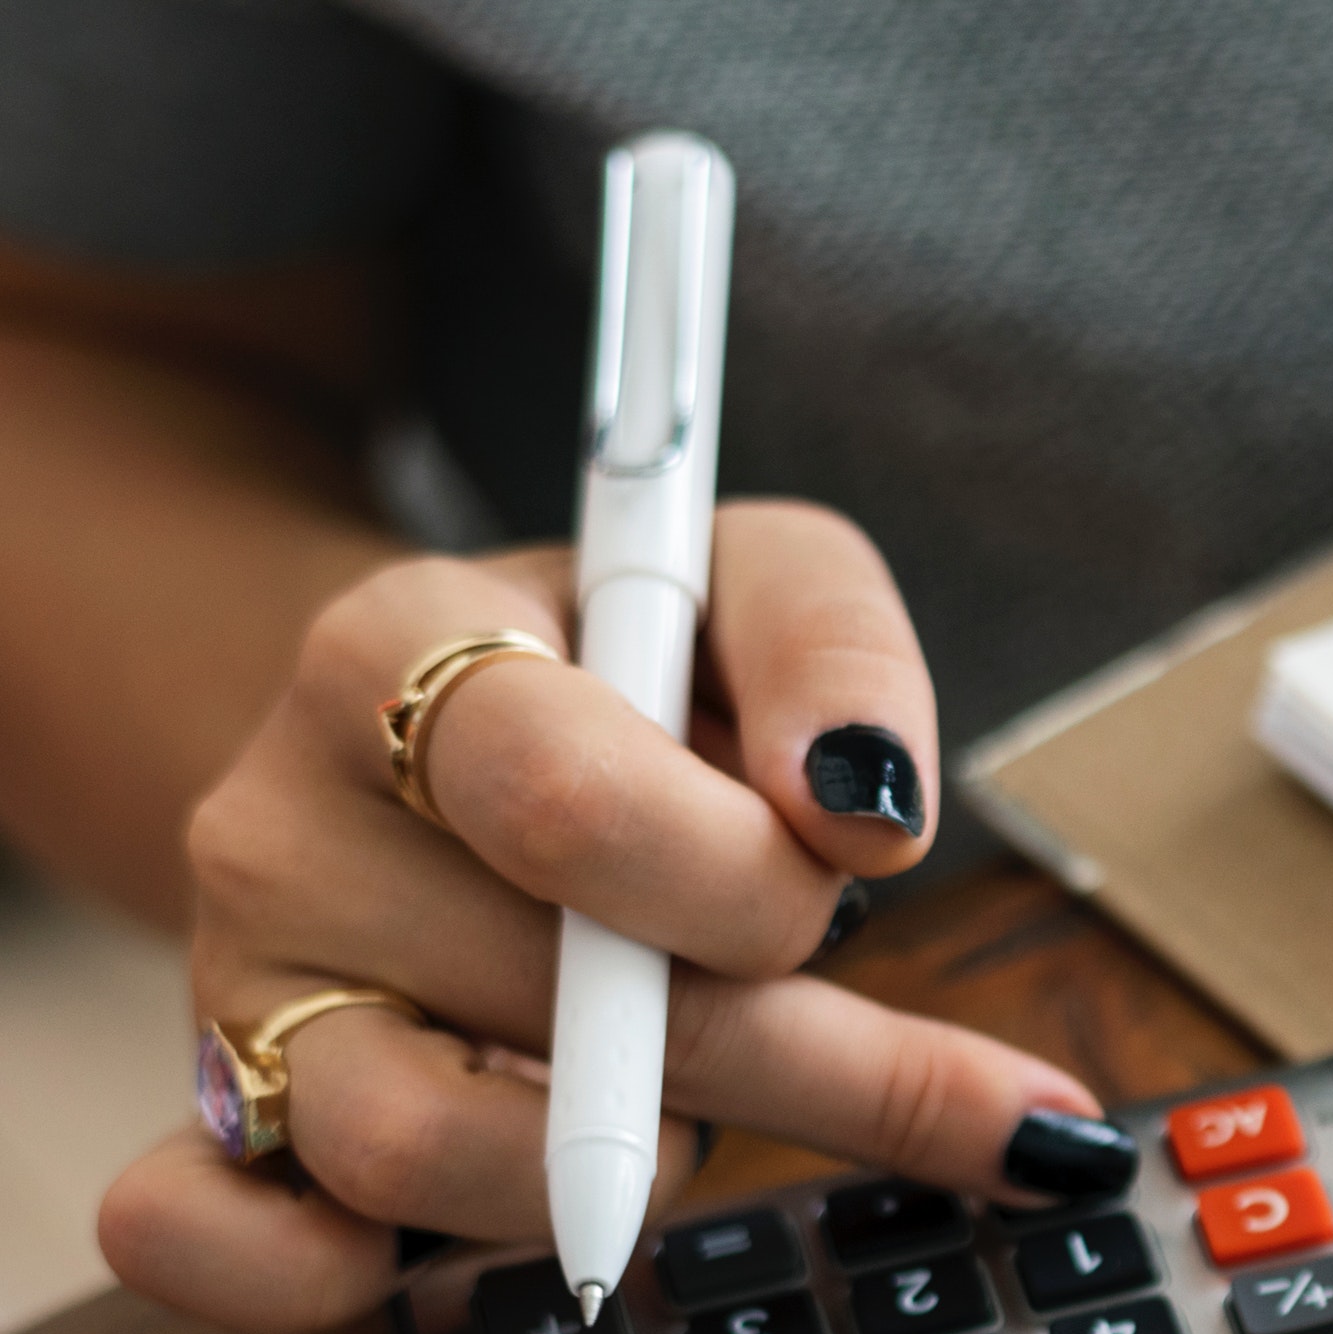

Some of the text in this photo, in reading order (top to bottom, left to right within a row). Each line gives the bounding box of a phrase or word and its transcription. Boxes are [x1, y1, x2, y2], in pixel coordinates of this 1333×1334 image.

[1195, 1102, 1269, 1147] AC
[1238, 1188, 1291, 1232] C
[1063, 1232, 1103, 1274] 1
[893, 1268, 939, 1316] 2
